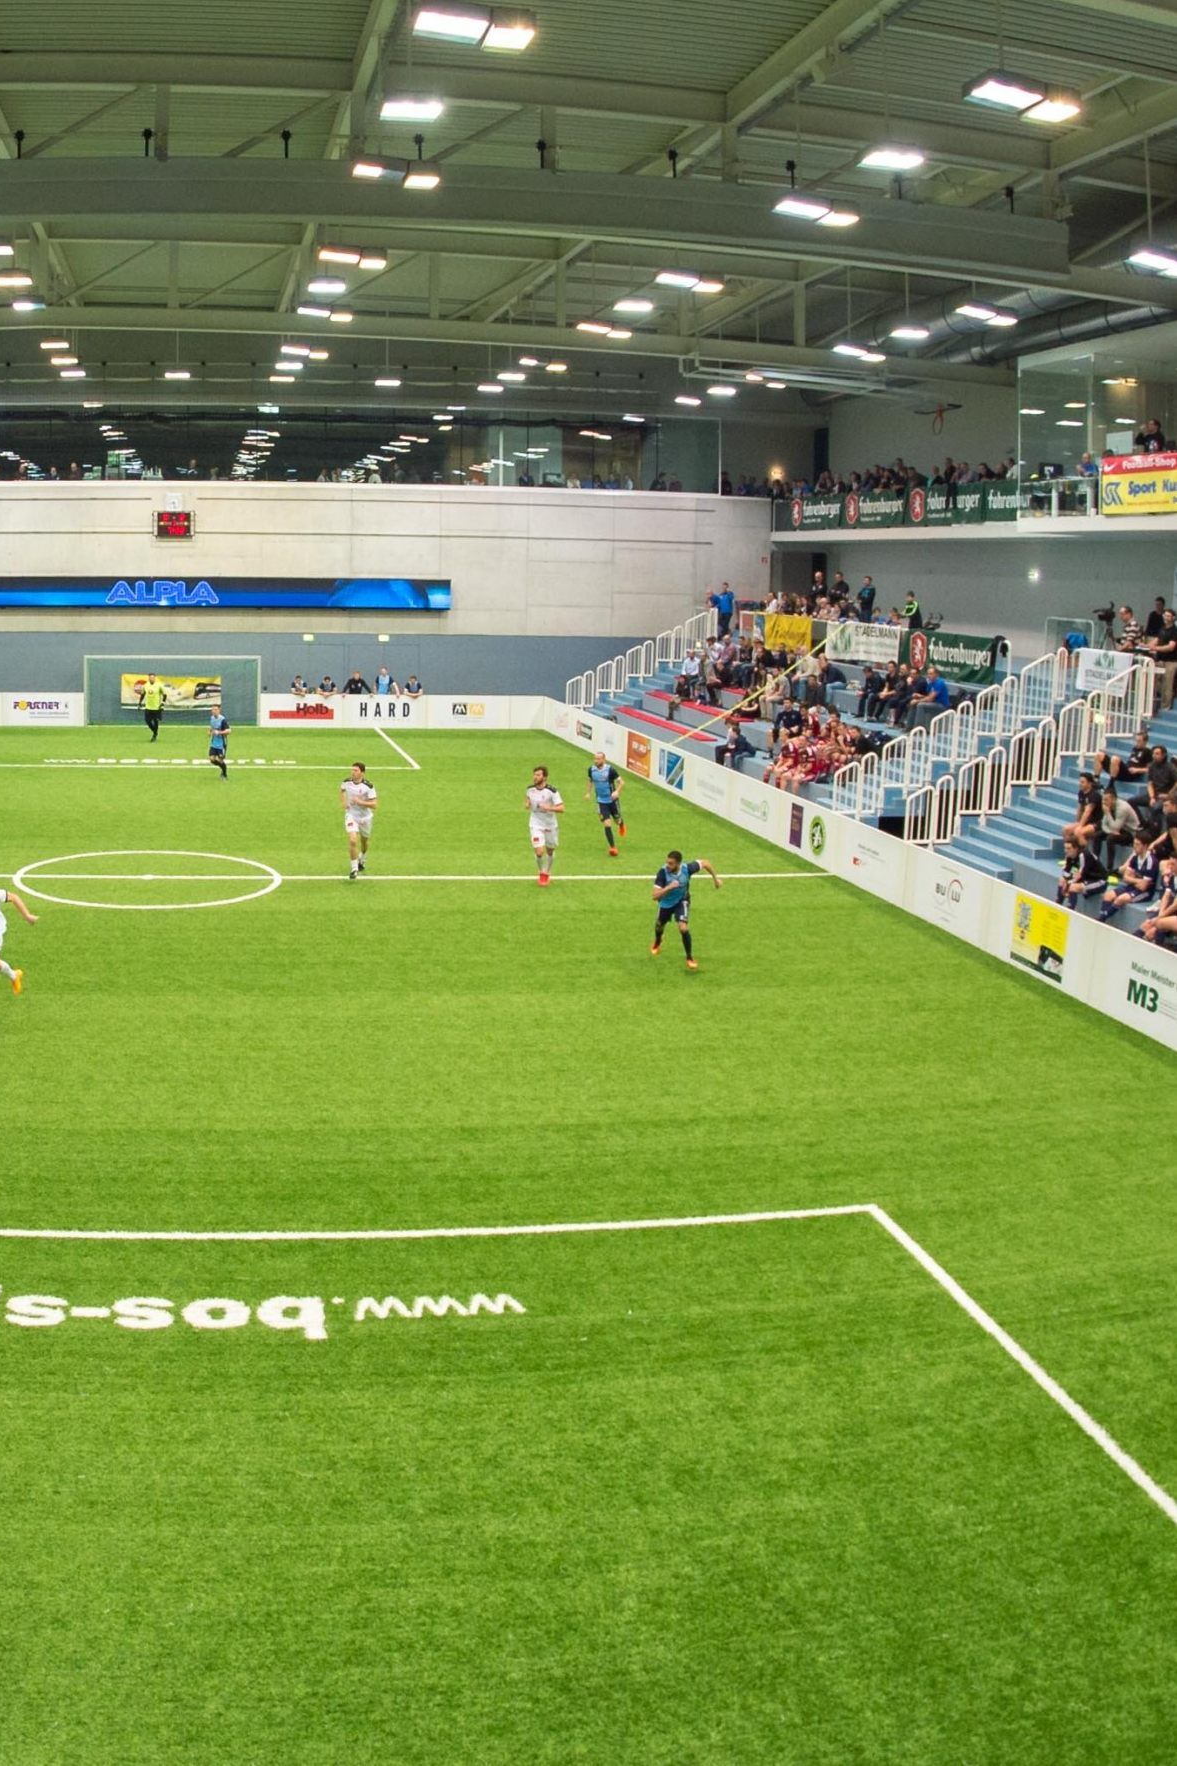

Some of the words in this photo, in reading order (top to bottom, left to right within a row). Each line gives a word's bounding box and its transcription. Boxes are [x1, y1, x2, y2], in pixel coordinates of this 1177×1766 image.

[1128, 480, 1157, 497] Sport
[106, 581, 220, 604] ALPLA
[360, 702, 410, 718] HARD
[1127, 978, 1159, 1013] M3
